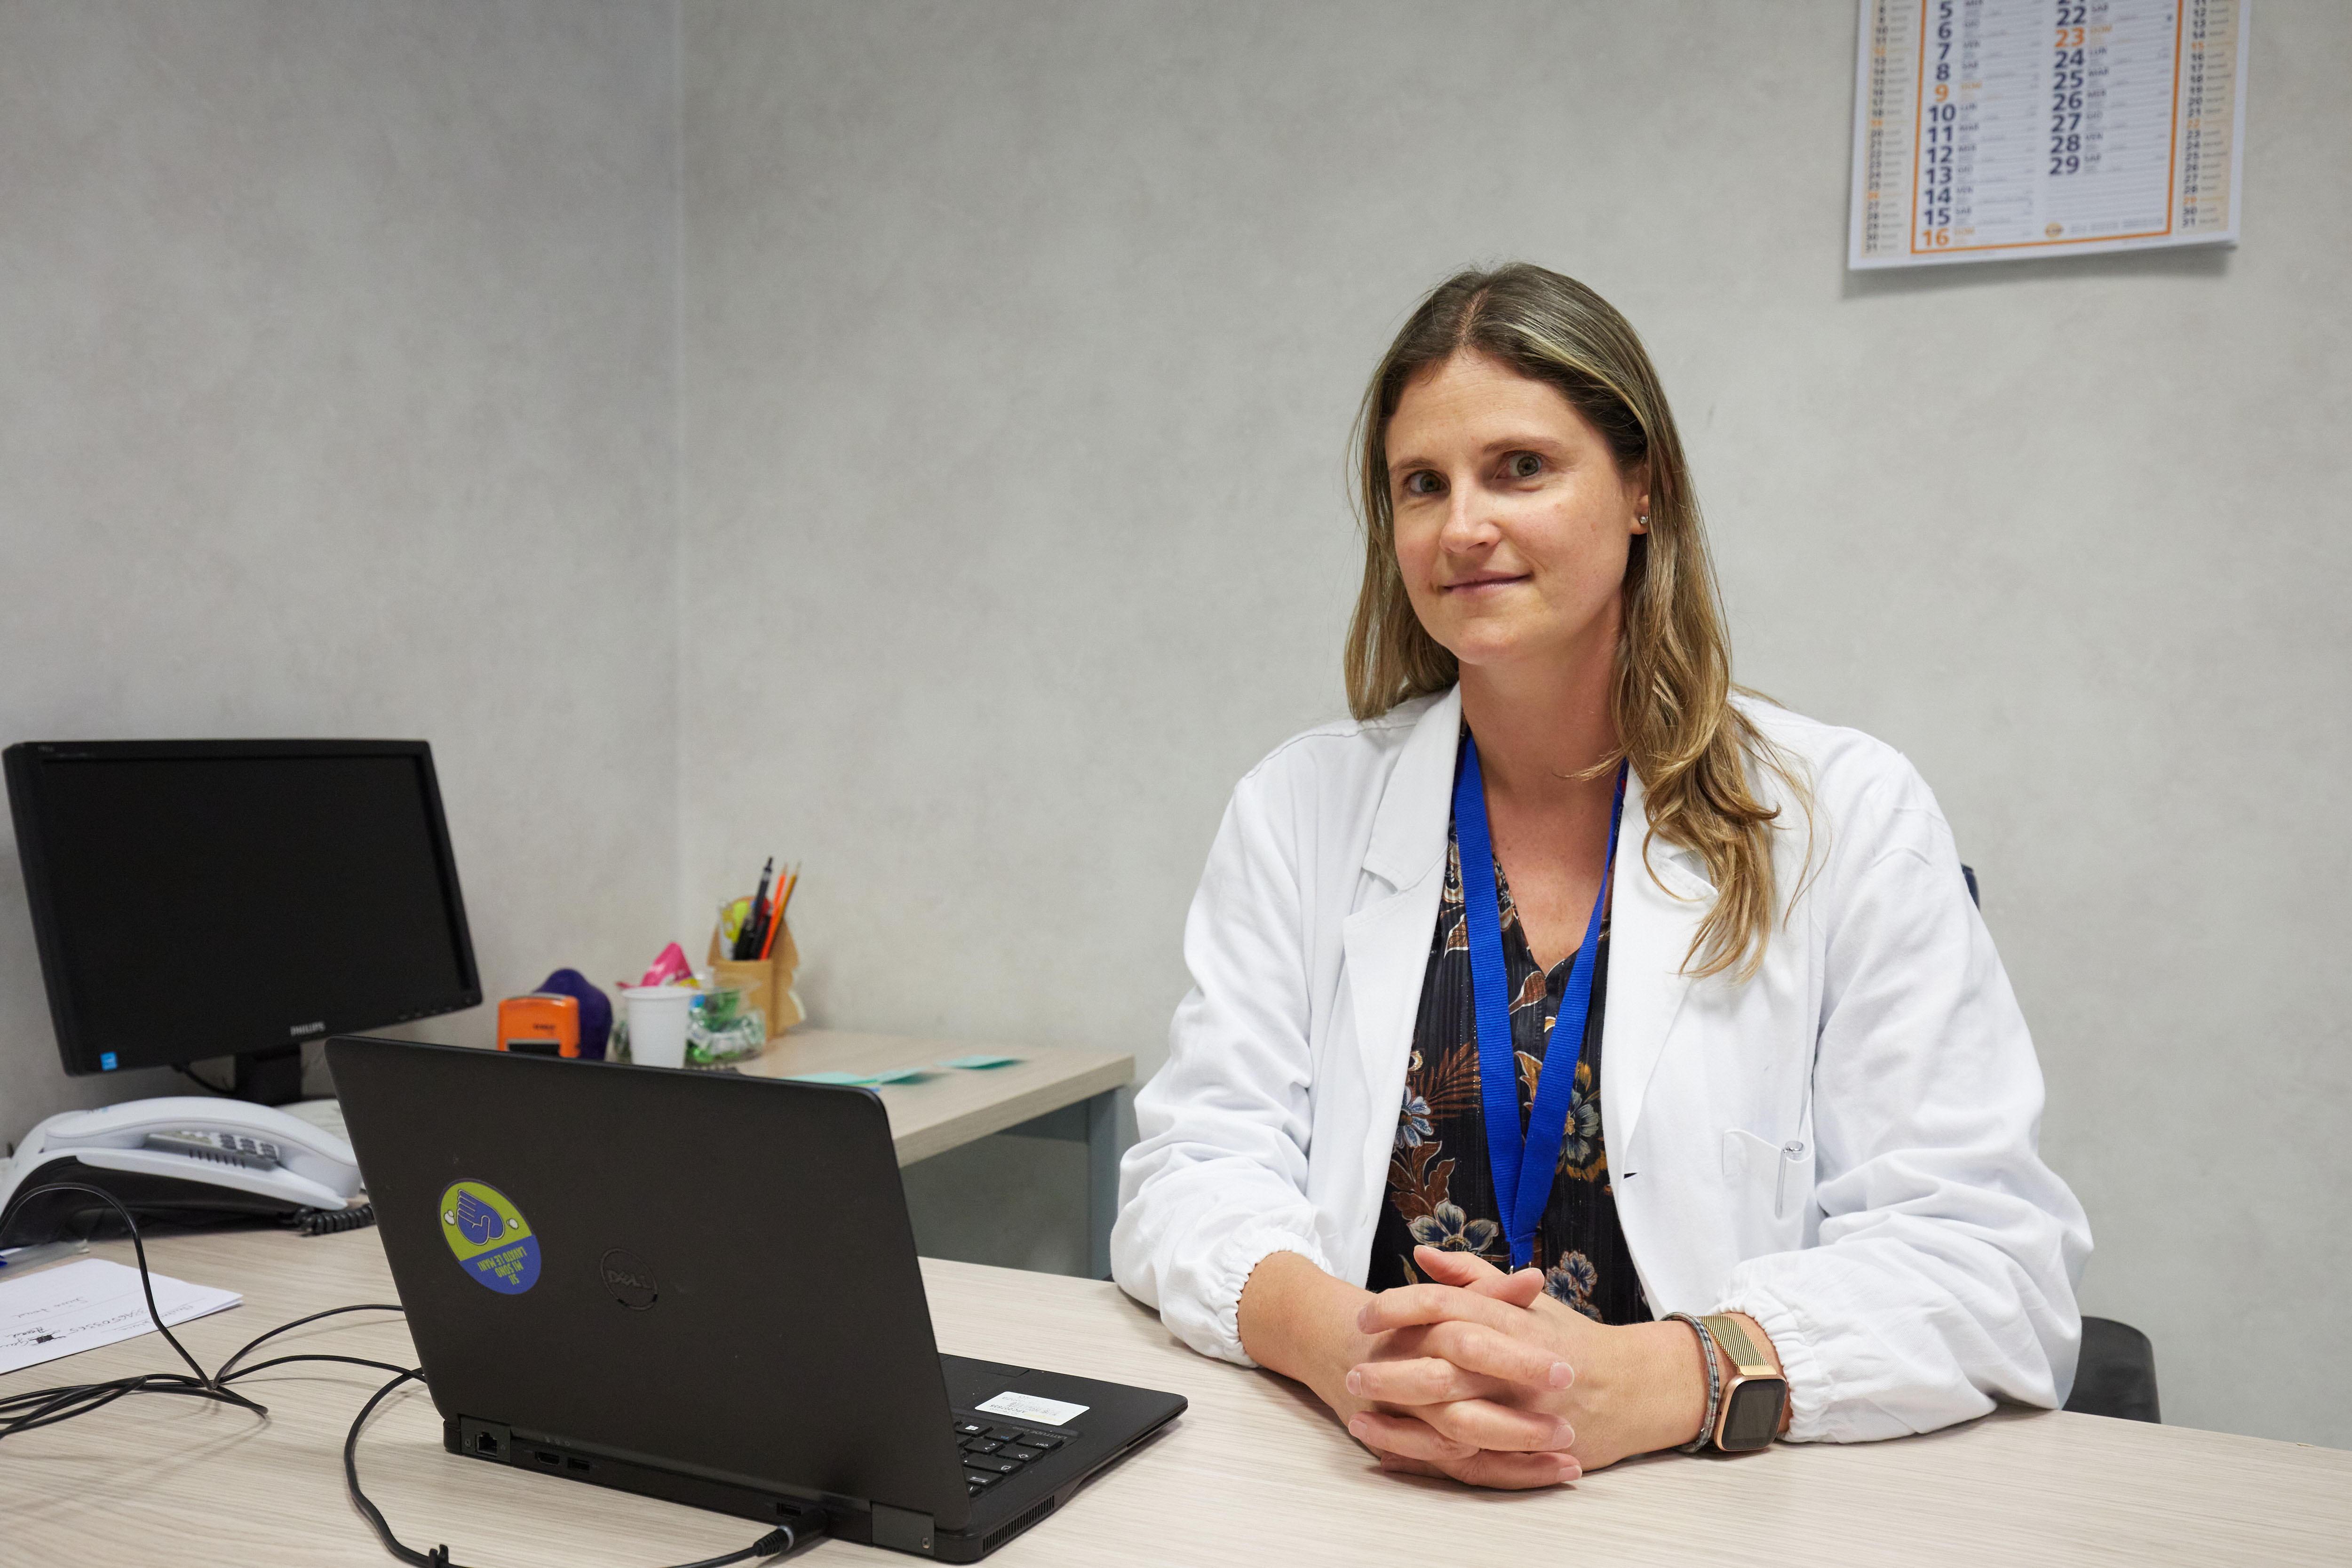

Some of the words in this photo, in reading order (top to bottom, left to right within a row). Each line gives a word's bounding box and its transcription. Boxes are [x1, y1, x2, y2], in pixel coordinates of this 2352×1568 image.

[1939, 0, 1952, 19] 5
[2057, 5, 2087, 26] 22
[1938, 22, 1951, 40] 6
[2055, 27, 2085, 48] 23
[1938, 42, 1950, 60] 7
[2054, 48, 2084, 69] 24
[1936, 63, 1950, 81] 8
[2053, 69, 2083, 90] 25
[1935, 84, 1949, 103] 9
[2052, 91, 2082, 111] 26
[1929, 103, 1956, 122] 10
[2051, 112, 2081, 132] 27
[1928, 124, 1953, 143] 11
[2050, 134, 2080, 154] 28
[1926, 145, 1953, 164] 12
[2050, 155, 2079, 175] 29
[1925, 166, 1952, 185] 13
[1924, 187, 1951, 205] 14
[1923, 207, 1950, 226] 15
[1922, 227, 1949, 246] 16
[290, 1021, 326, 1037] PHILIPS
[493, 1254, 505, 1266] LE
[502, 1246, 527, 1263] LAVATO
[477, 1257, 497, 1272] MANI
[495, 1263, 515, 1278] SONO
[511, 1259, 524, 1272] MI
[1030, 1430, 1068, 1440] LATITUDE
